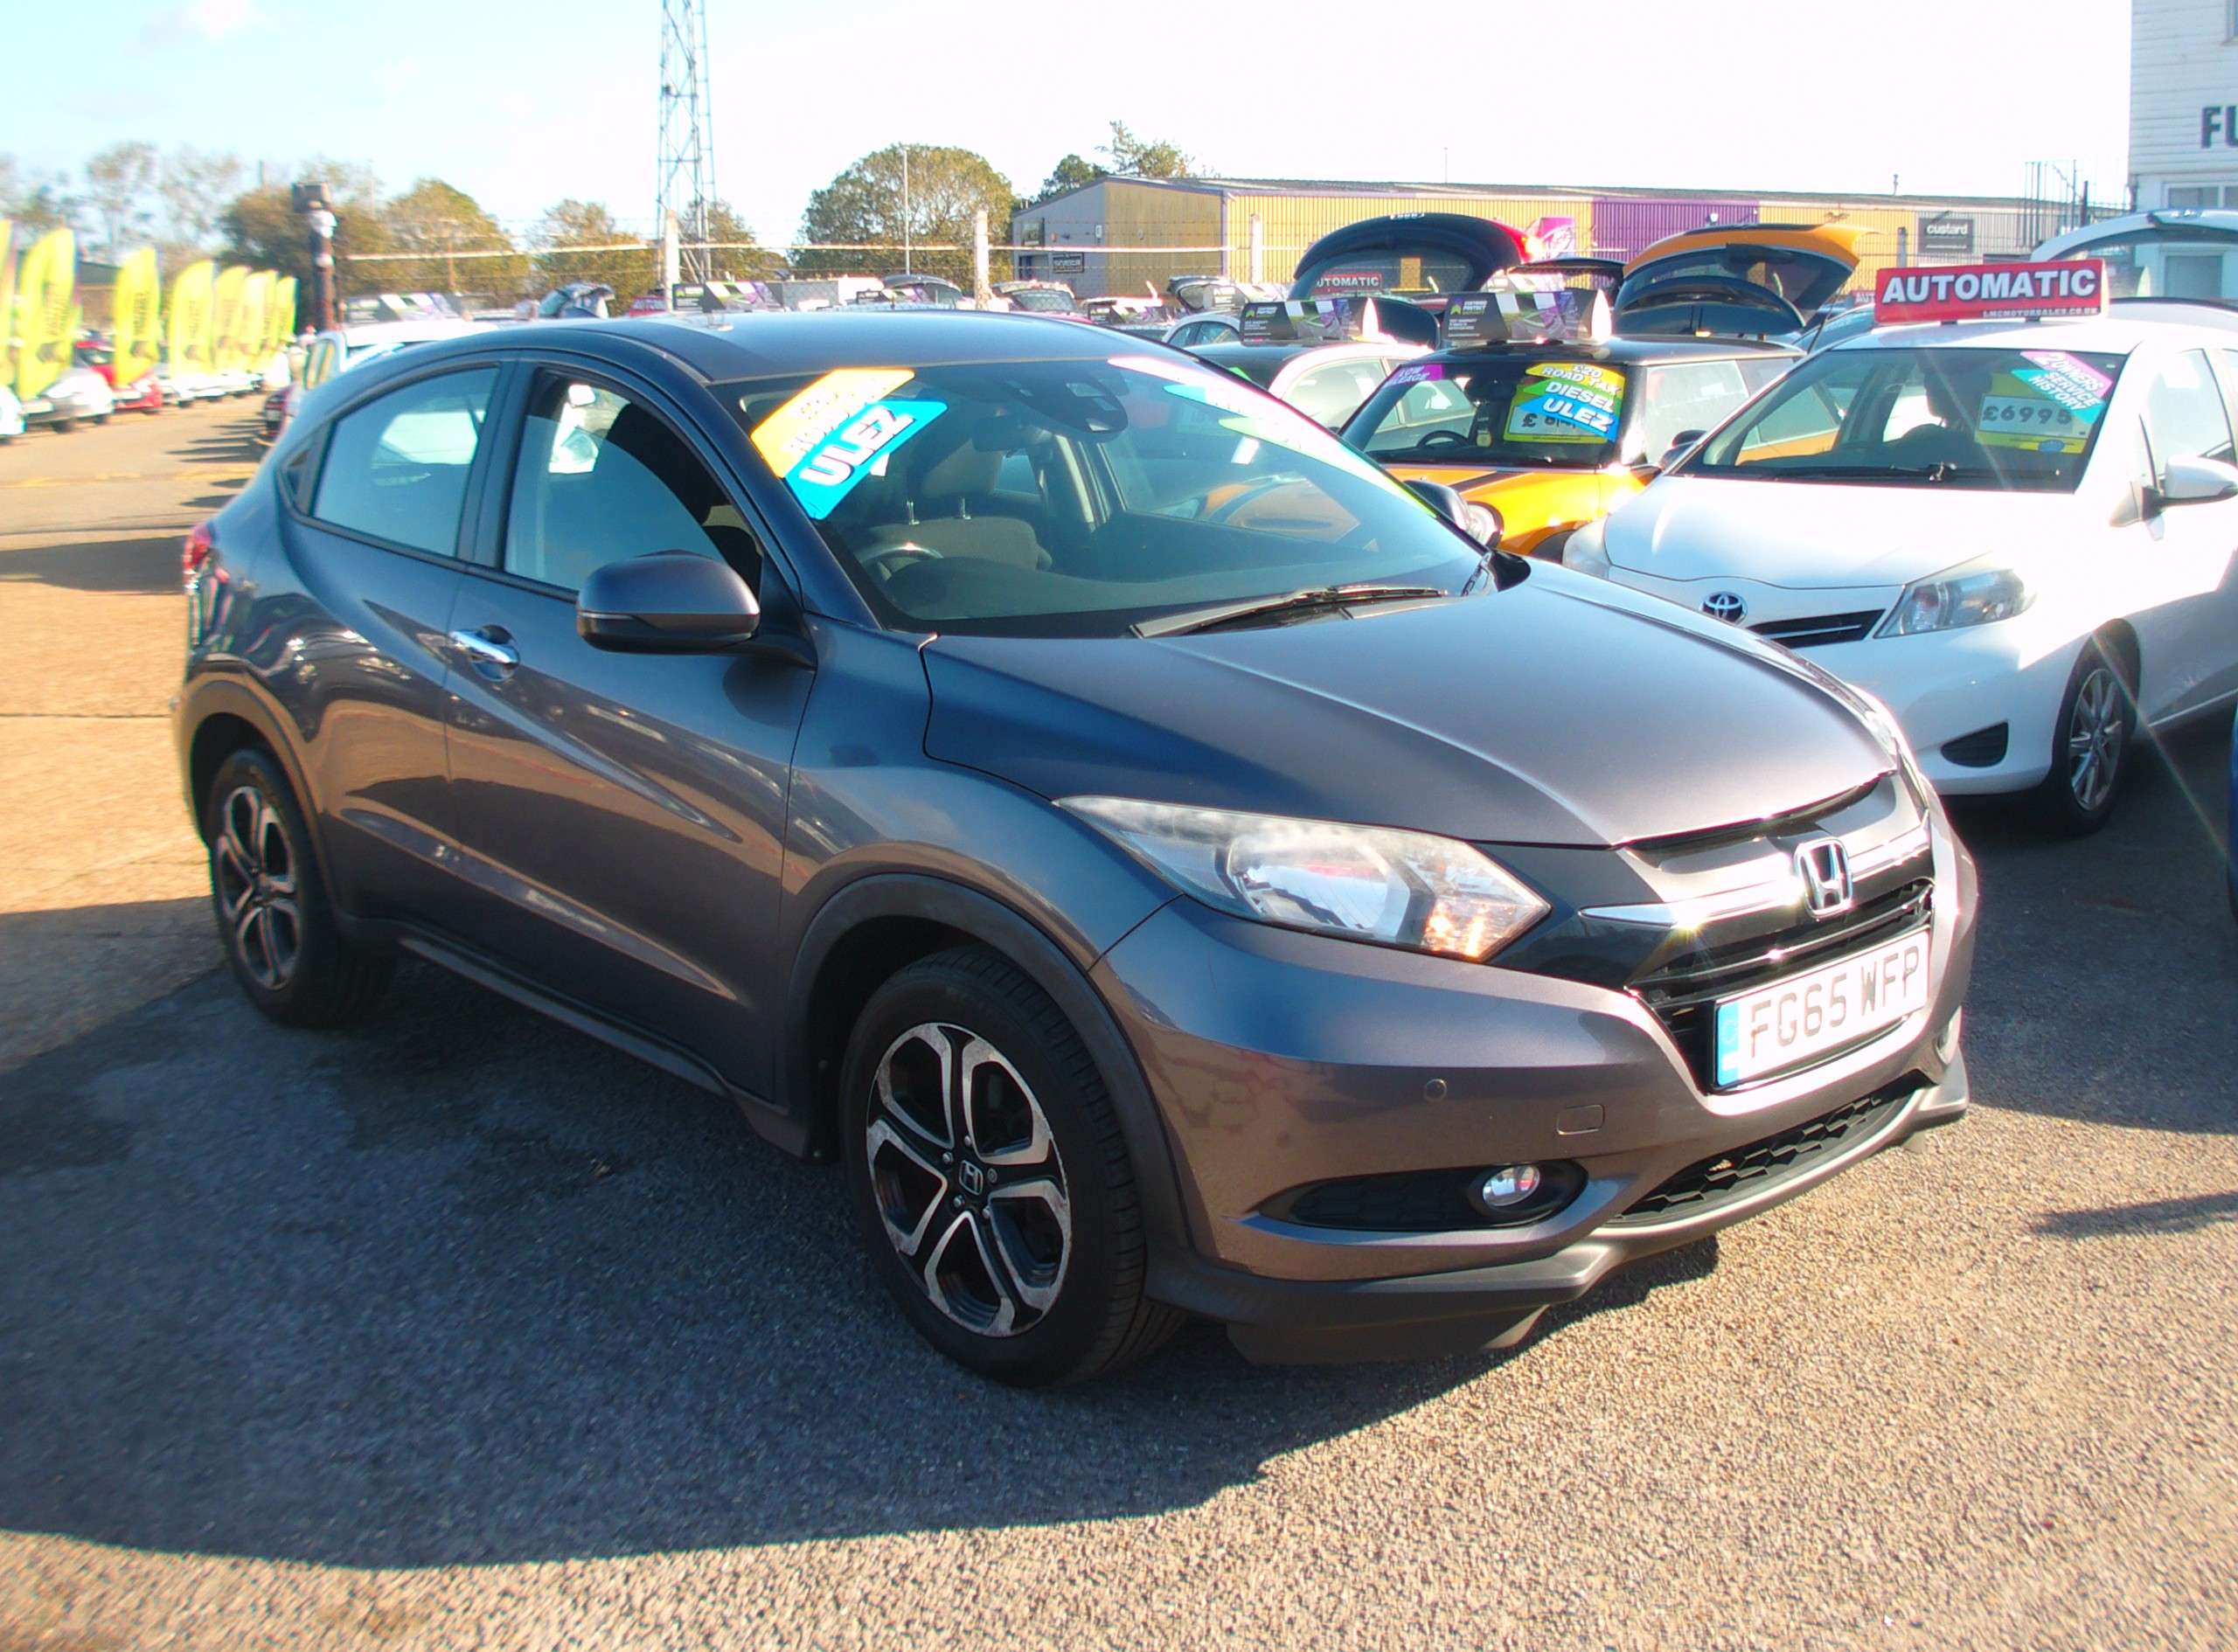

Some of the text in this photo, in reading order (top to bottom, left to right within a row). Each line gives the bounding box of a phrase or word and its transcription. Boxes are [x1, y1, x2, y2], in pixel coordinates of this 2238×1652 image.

[1316, 276, 1380, 288] UTOMATIC
[1881, 269, 2096, 303] AUTOMATIC
[1541, 367, 1584, 382] ROAD
[1545, 381, 1614, 413] DIESEL
[2027, 374, 2089, 411] HISTORY
[1543, 397, 1615, 434] ULEZ
[797, 405, 917, 486] ULEZ
[1750, 945, 1920, 1059] FG65 WFP
